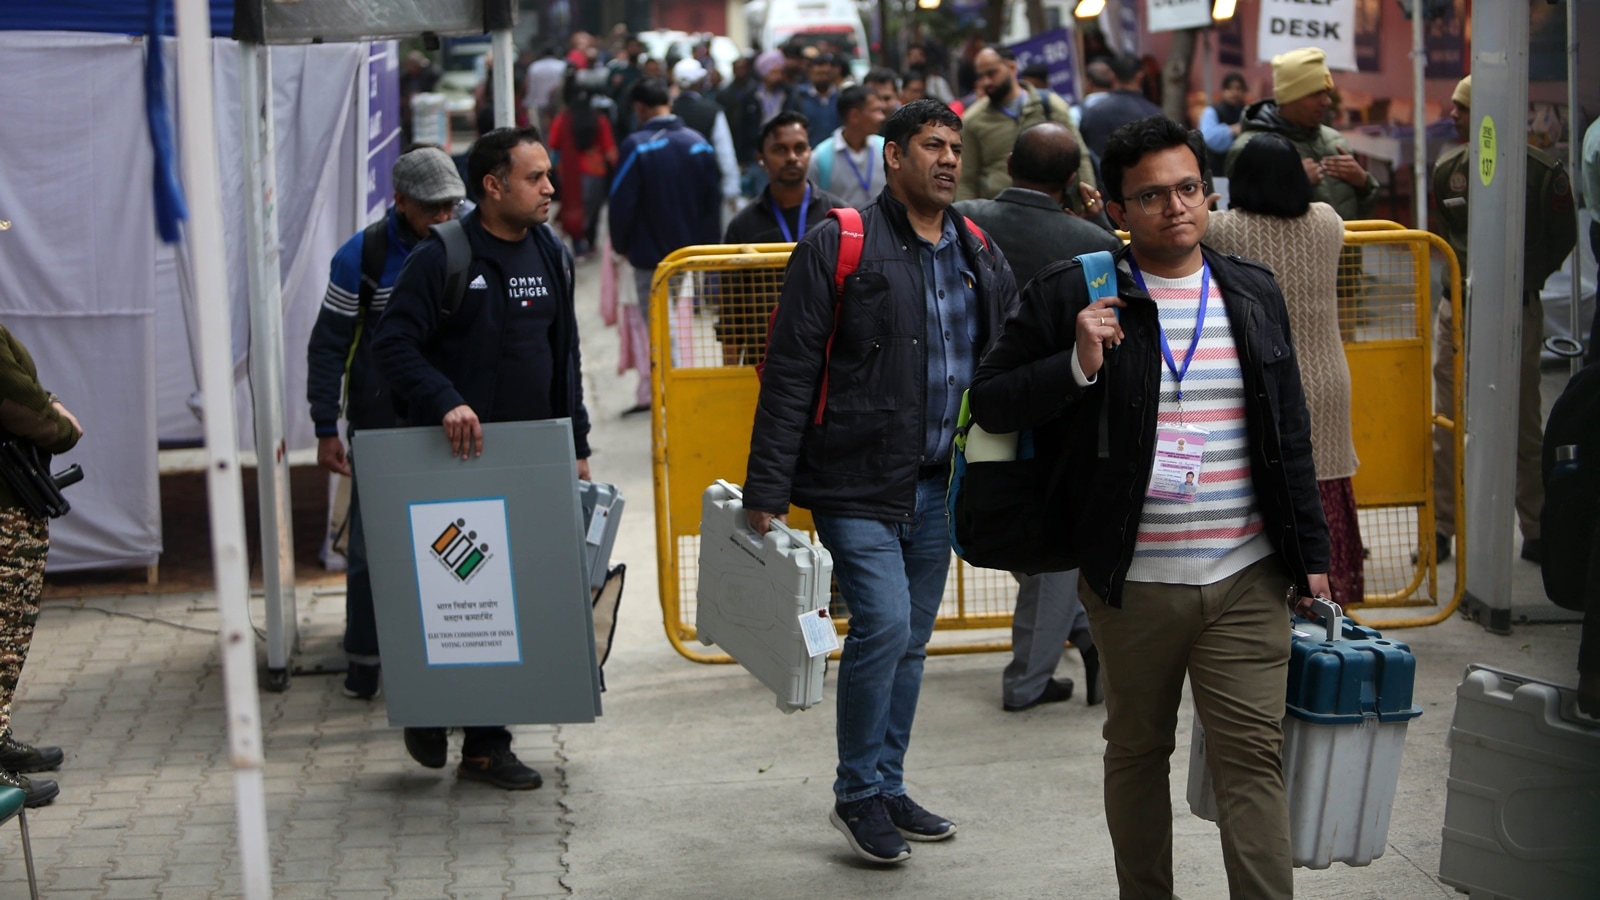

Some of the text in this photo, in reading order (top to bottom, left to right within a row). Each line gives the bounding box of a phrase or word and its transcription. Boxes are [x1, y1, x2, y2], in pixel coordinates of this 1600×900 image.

[1270, 17, 1341, 40] DESK
[1482, 158, 1493, 176] 137
[509, 277, 542, 287] OMMY
[509, 287, 548, 298] ILFIGER
[453, 601, 476, 609] निर्वाचन
[479, 599, 498, 609] आयोग
[444, 614, 463, 622] मतदान
[454, 631, 489, 639] COMMISSION
[462, 640, 502, 648] COMPARTMENT
